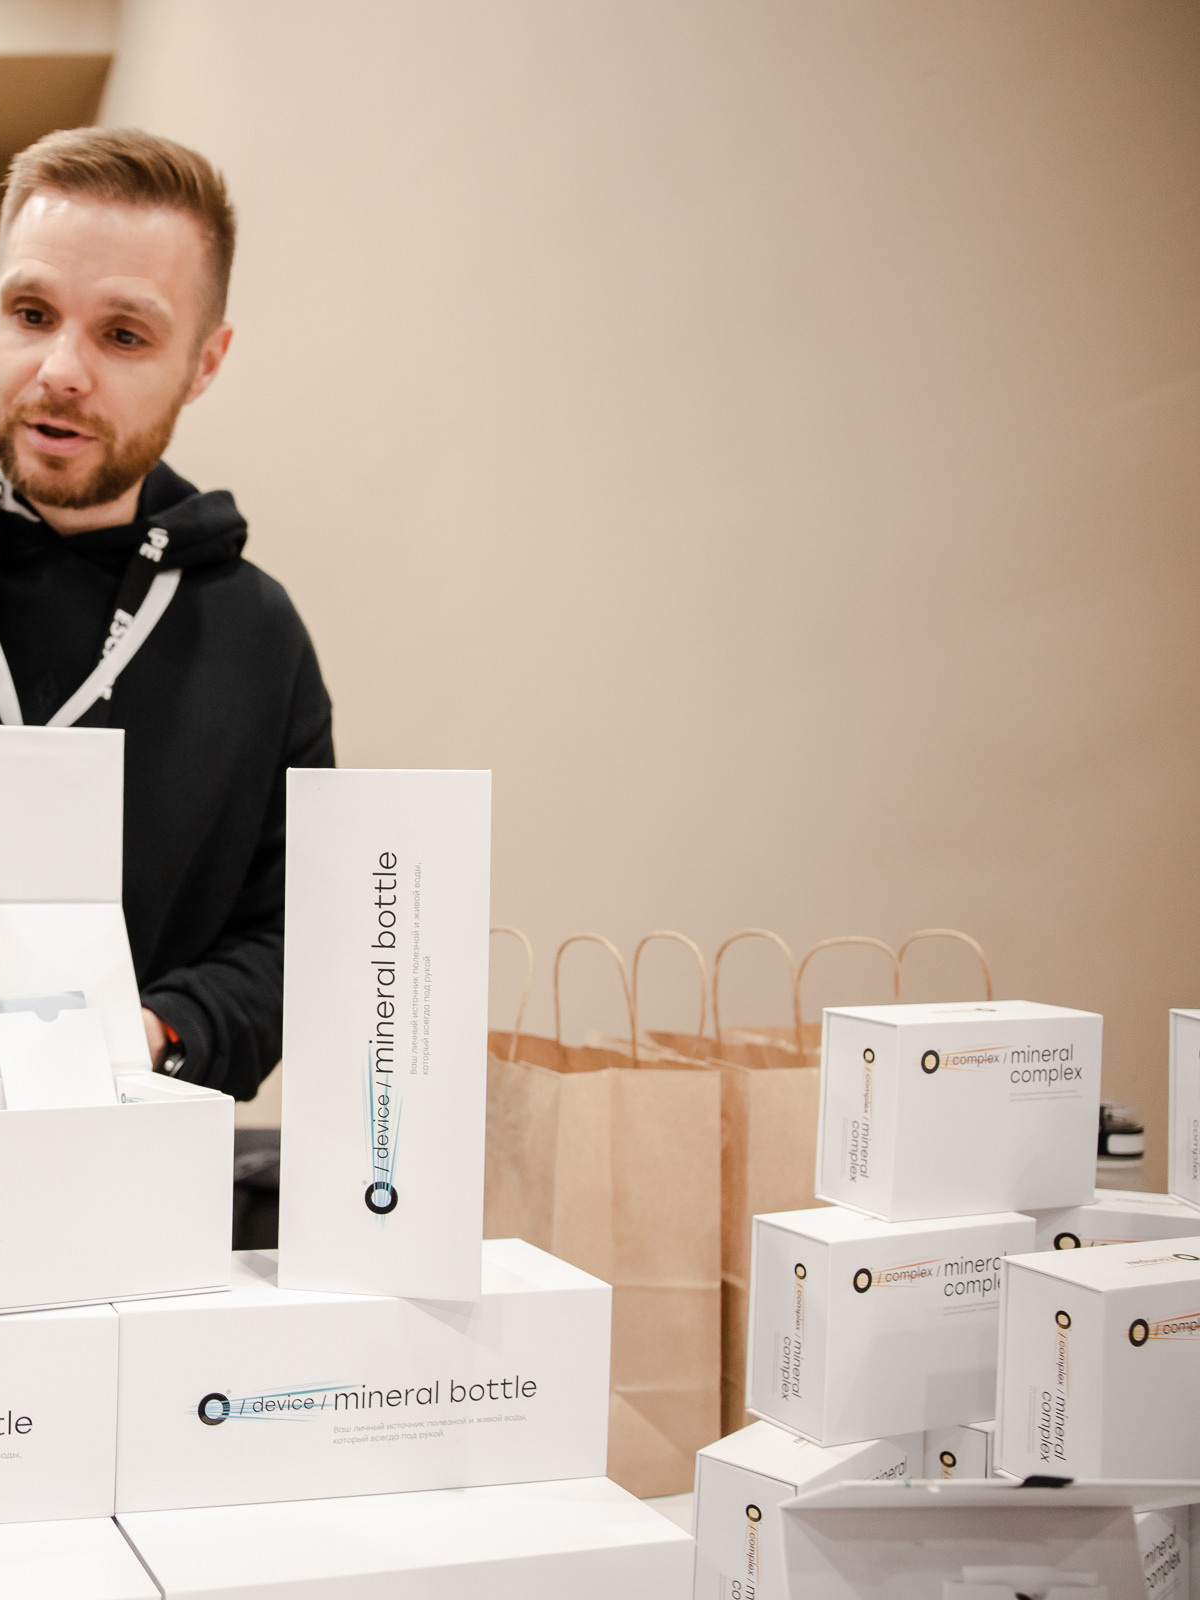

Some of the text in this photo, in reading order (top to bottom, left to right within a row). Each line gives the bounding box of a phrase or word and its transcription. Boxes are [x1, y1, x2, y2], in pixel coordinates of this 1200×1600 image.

[371, 852, 398, 948] bottle
[368, 961, 396, 1074] mineral
[952, 1052, 1000, 1067] complex
[1011, 1043, 1074, 1064] mineral
[1010, 1064, 1082, 1086] complex
[372, 1094, 390, 1159] device
[849, 1119, 860, 1184] complex
[859, 1122, 872, 1179] mineral
[885, 1266, 933, 1283] complex
[252, 1395, 314, 1413] device
[335, 1381, 439, 1411] mineral
[450, 1375, 537, 1403] bottle
[781, 1336, 791, 1401] complex
[791, 1340, 803, 1398] mineral
[1038, 1391, 1052, 1463] complex
[1054, 1395, 1069, 1462] mineral
